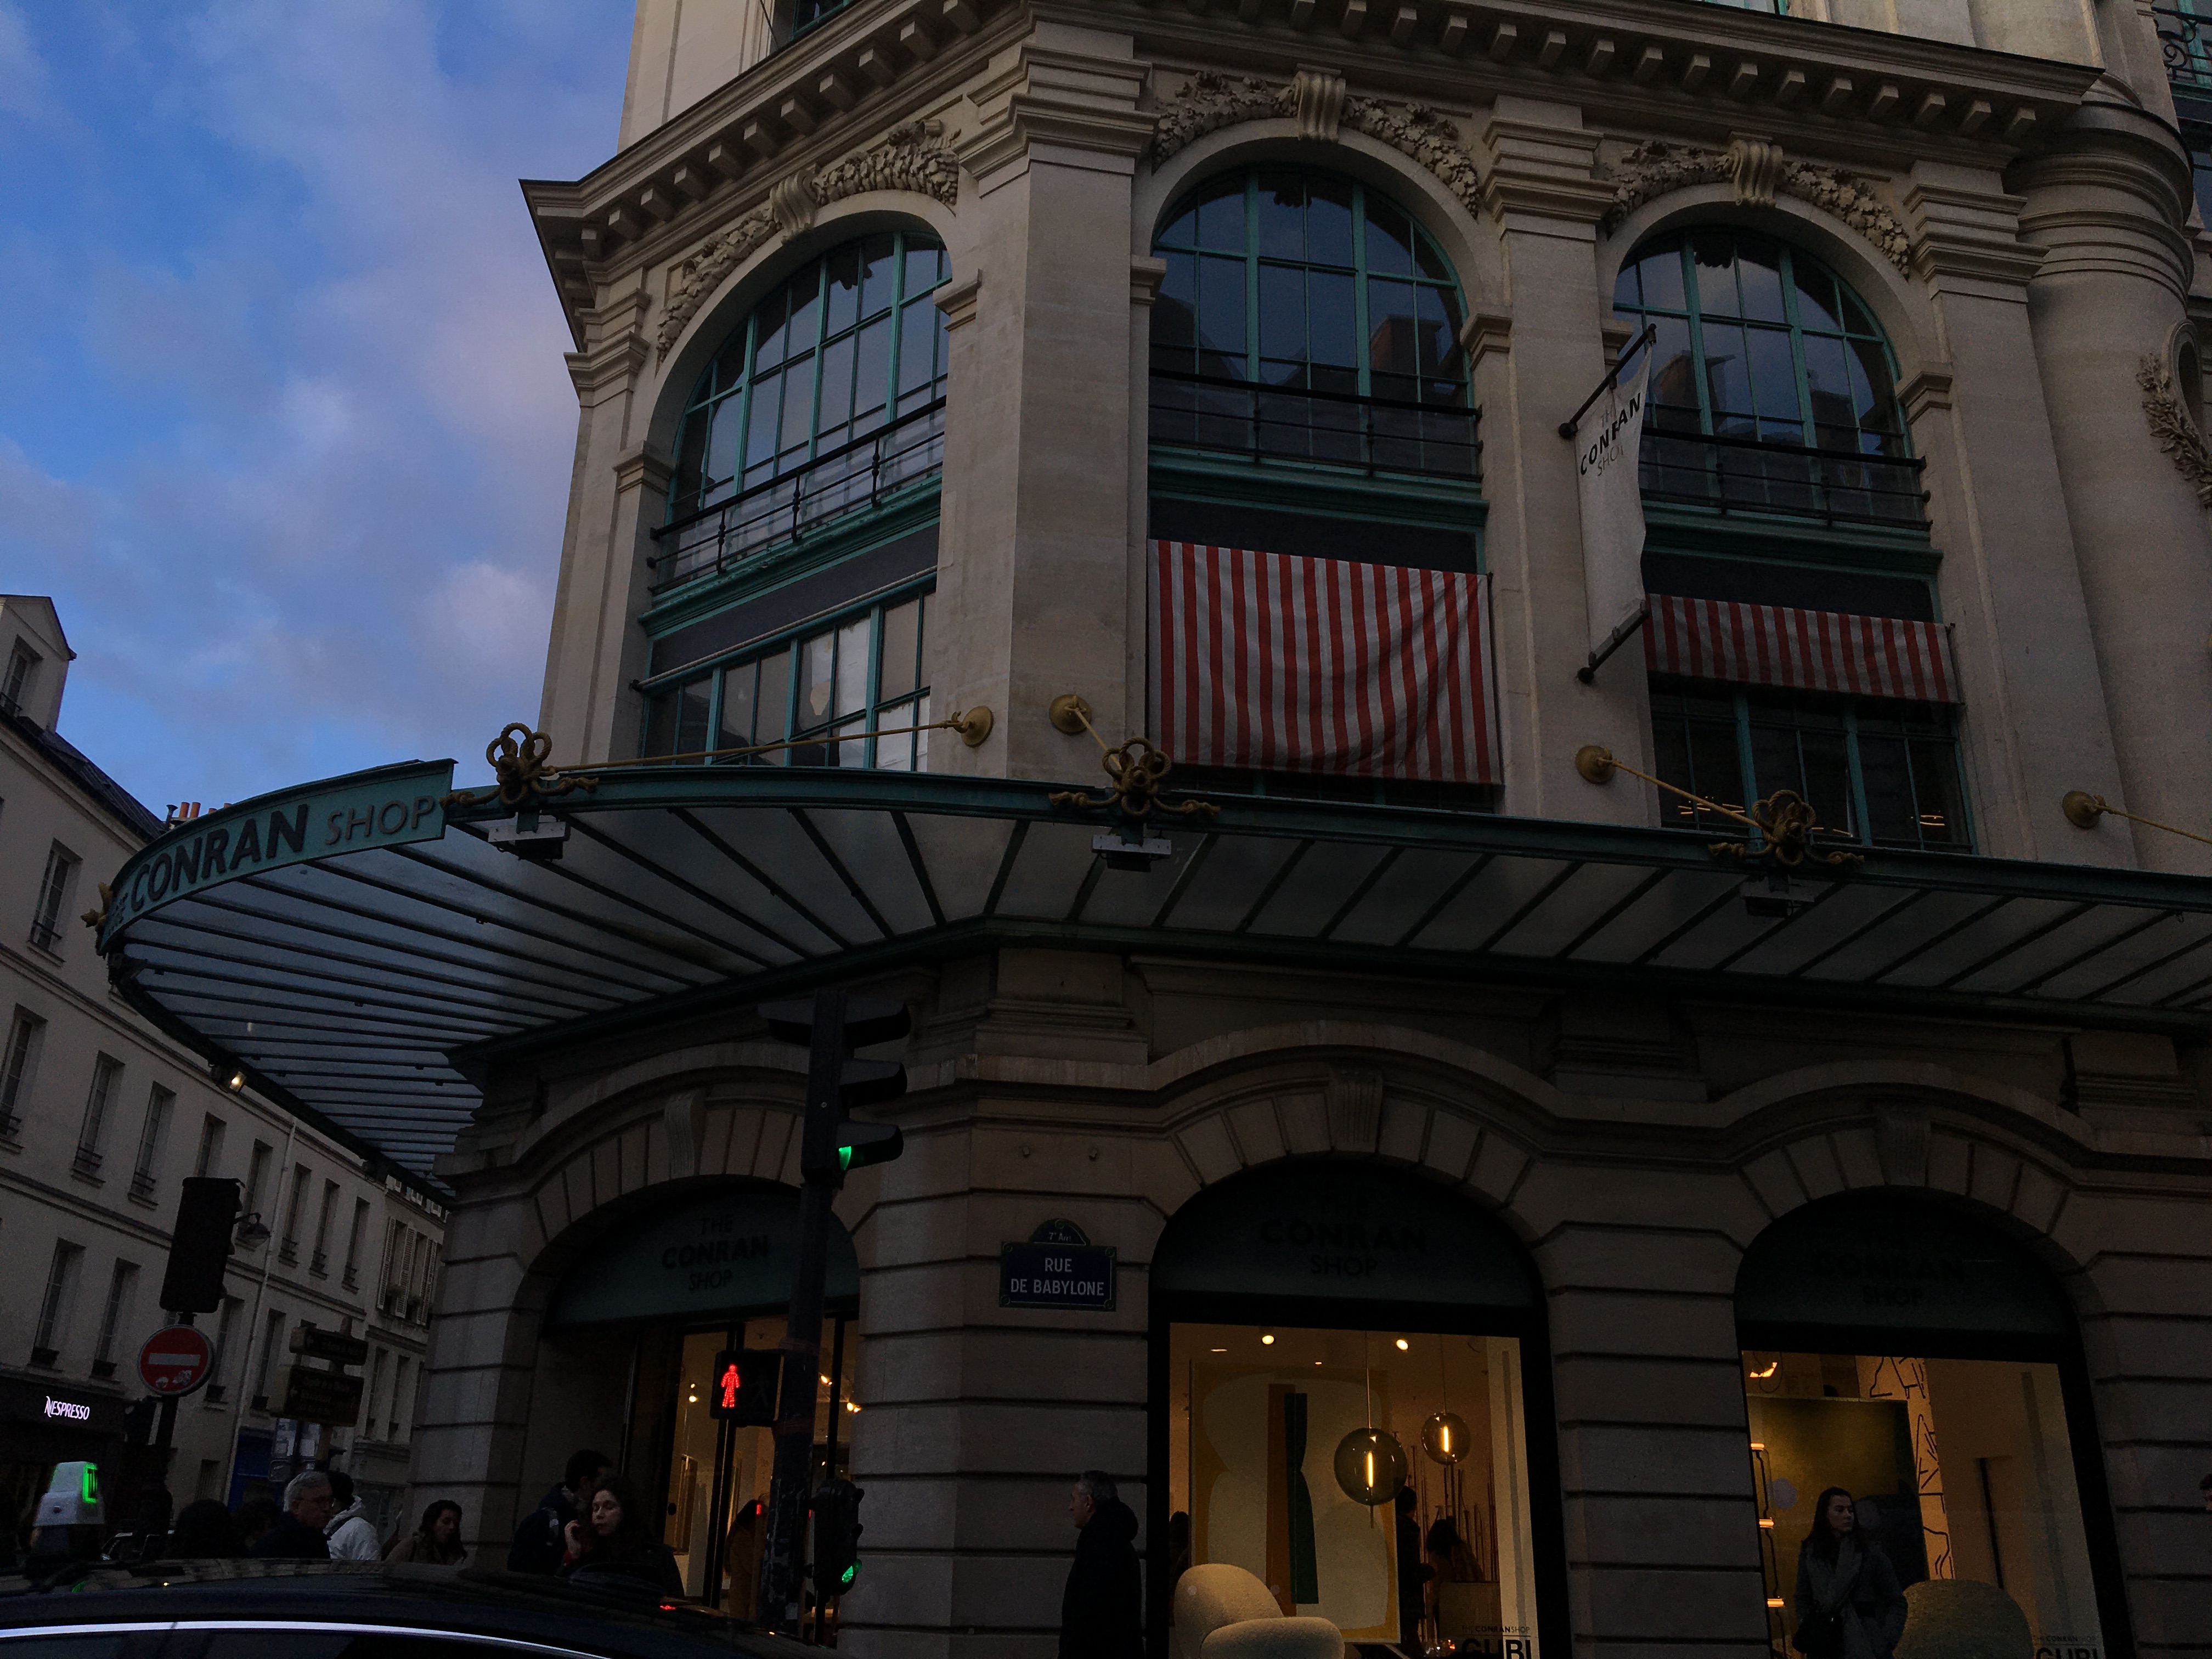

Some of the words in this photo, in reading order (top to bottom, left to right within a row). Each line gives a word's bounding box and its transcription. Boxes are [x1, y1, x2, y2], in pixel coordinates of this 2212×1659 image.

[131, 804, 307, 912] CONRAN
[325, 795, 435, 844] SHOP
[699, 1214, 733, 1235] THE
[1261, 1219, 1426, 1251] CONRAN
[662, 1234, 768, 1268] CONRAN
[1045, 1257, 1072, 1273] RUE
[1311, 1255, 1378, 1276] SHOP
[689, 1269, 732, 1290] SHOP
[1011, 1278, 1027, 1293] DE
[1033, 1279, 1104, 1296] BABYLONE
[1863, 1284, 1923, 1306] SHOP
